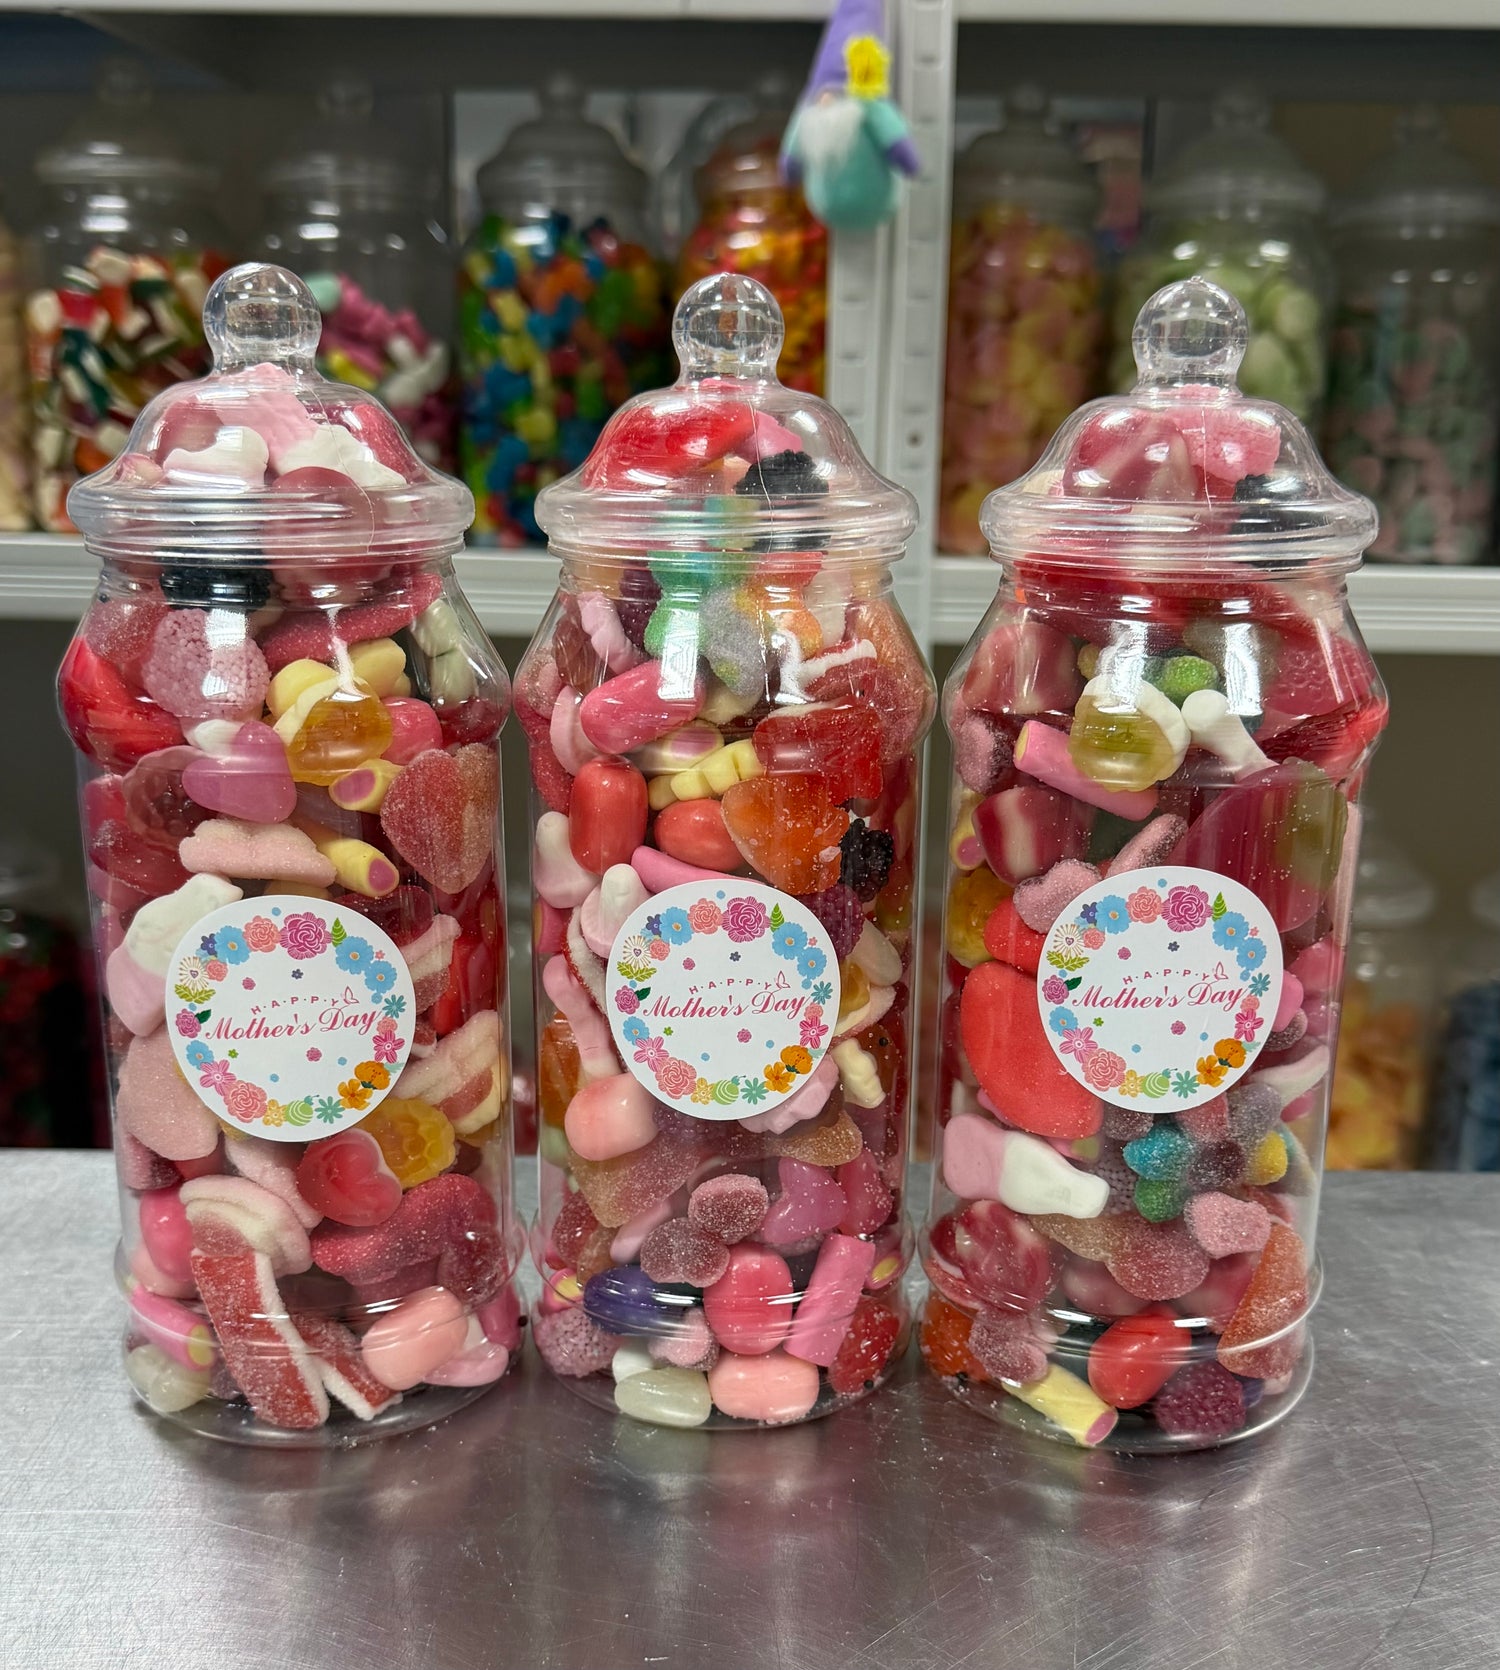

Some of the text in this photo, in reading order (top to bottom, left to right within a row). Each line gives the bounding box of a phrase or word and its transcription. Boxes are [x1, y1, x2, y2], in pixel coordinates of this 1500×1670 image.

[643, 990, 811, 1020] Mother's Day
[1072, 982, 1249, 1012] Mother's Day
[205, 1006, 382, 1040] Mother's Day
